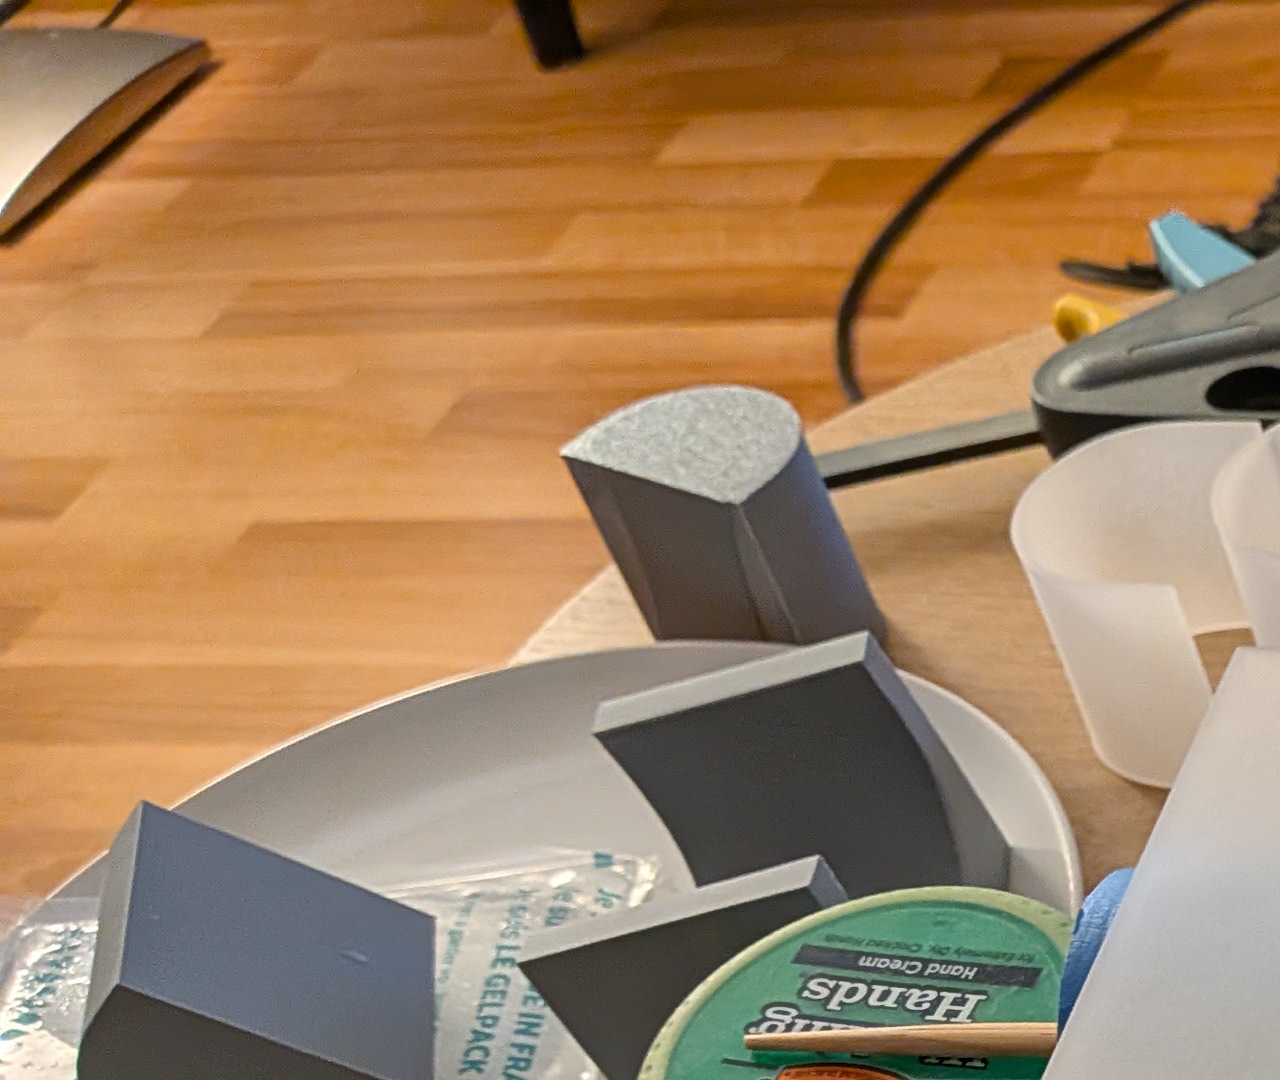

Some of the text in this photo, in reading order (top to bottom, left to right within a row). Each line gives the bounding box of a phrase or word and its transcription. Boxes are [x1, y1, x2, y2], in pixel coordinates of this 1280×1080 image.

[490, 943, 521, 969] LE
[857, 956, 979, 980] Hand Cream
[800, 977, 988, 1023] Hands
[457, 974, 511, 1076] GELPACK
[513, 1009, 545, 1038] IN
